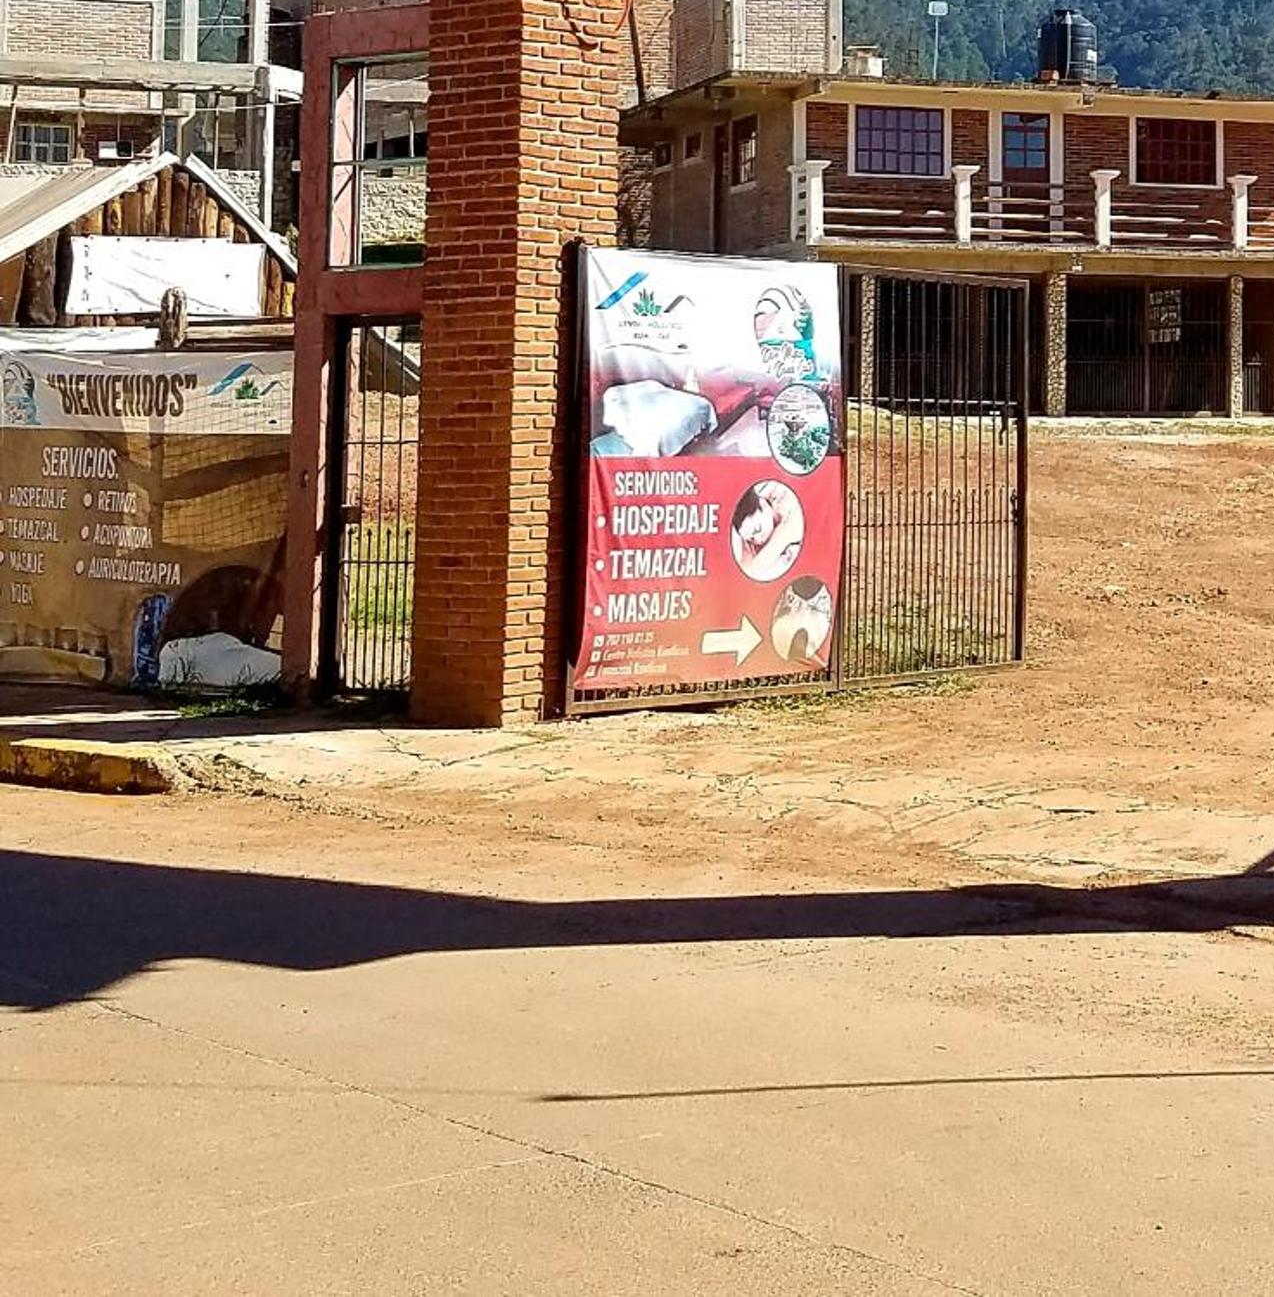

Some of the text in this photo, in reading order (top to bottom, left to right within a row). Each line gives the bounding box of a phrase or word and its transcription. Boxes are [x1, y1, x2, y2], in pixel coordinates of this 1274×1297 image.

[614, 470, 699, 496] SERVICIOS:
[9, 486, 68, 510] HOSPEDAJE
[8, 518, 60, 543] TEMAZCAL
[612, 503, 720, 536] HOSPEDAJE
[9, 551, 46, 574] MASAJE
[87, 556, 182, 586] AURICULOTERAPIA
[609, 547, 708, 580] TEMAZCAL
[608, 590, 693, 623] MASAJES
